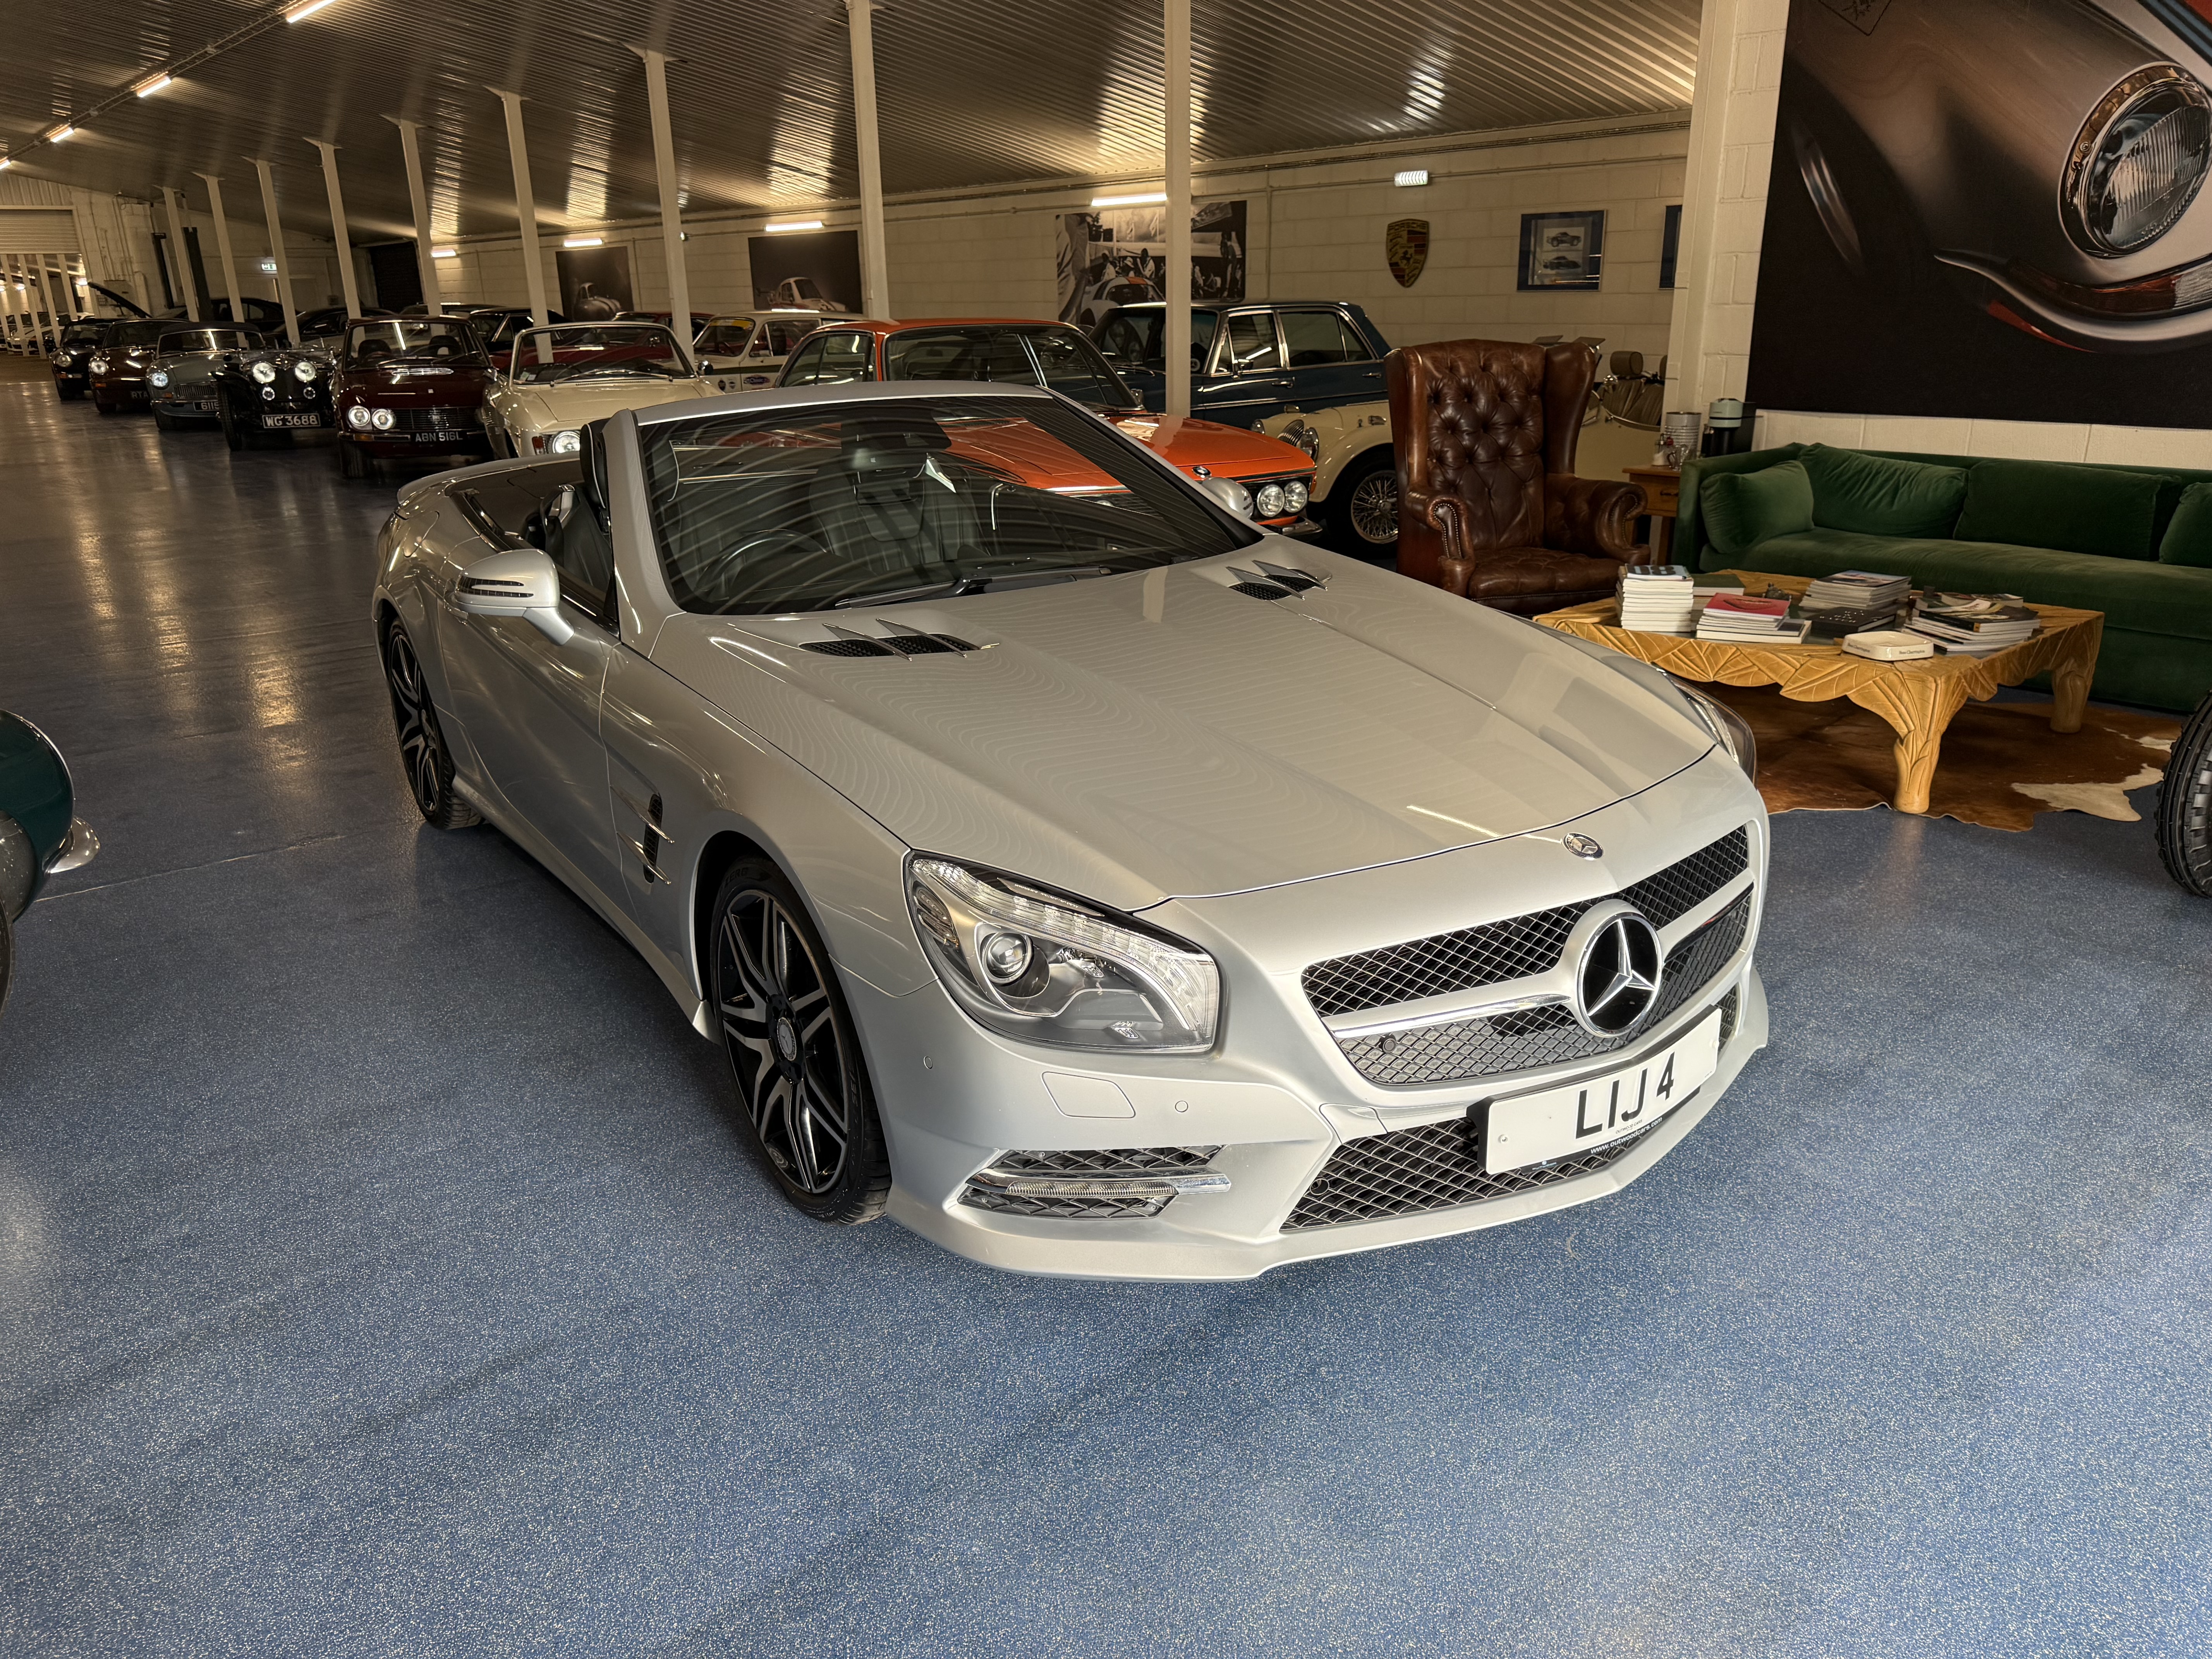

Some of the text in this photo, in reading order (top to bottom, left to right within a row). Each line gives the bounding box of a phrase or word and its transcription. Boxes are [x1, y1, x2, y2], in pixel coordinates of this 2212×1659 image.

[131, 391, 149, 399] RTA
[266, 415, 318, 426] WG 3688
[415, 431, 463, 442] ABN 516L
[1575, 1051, 1675, 1139] LIJ 4
[1616, 1123, 1633, 1134] OUTWOOD
[1590, 1117, 1662, 1154] www.outwoodcars.com
